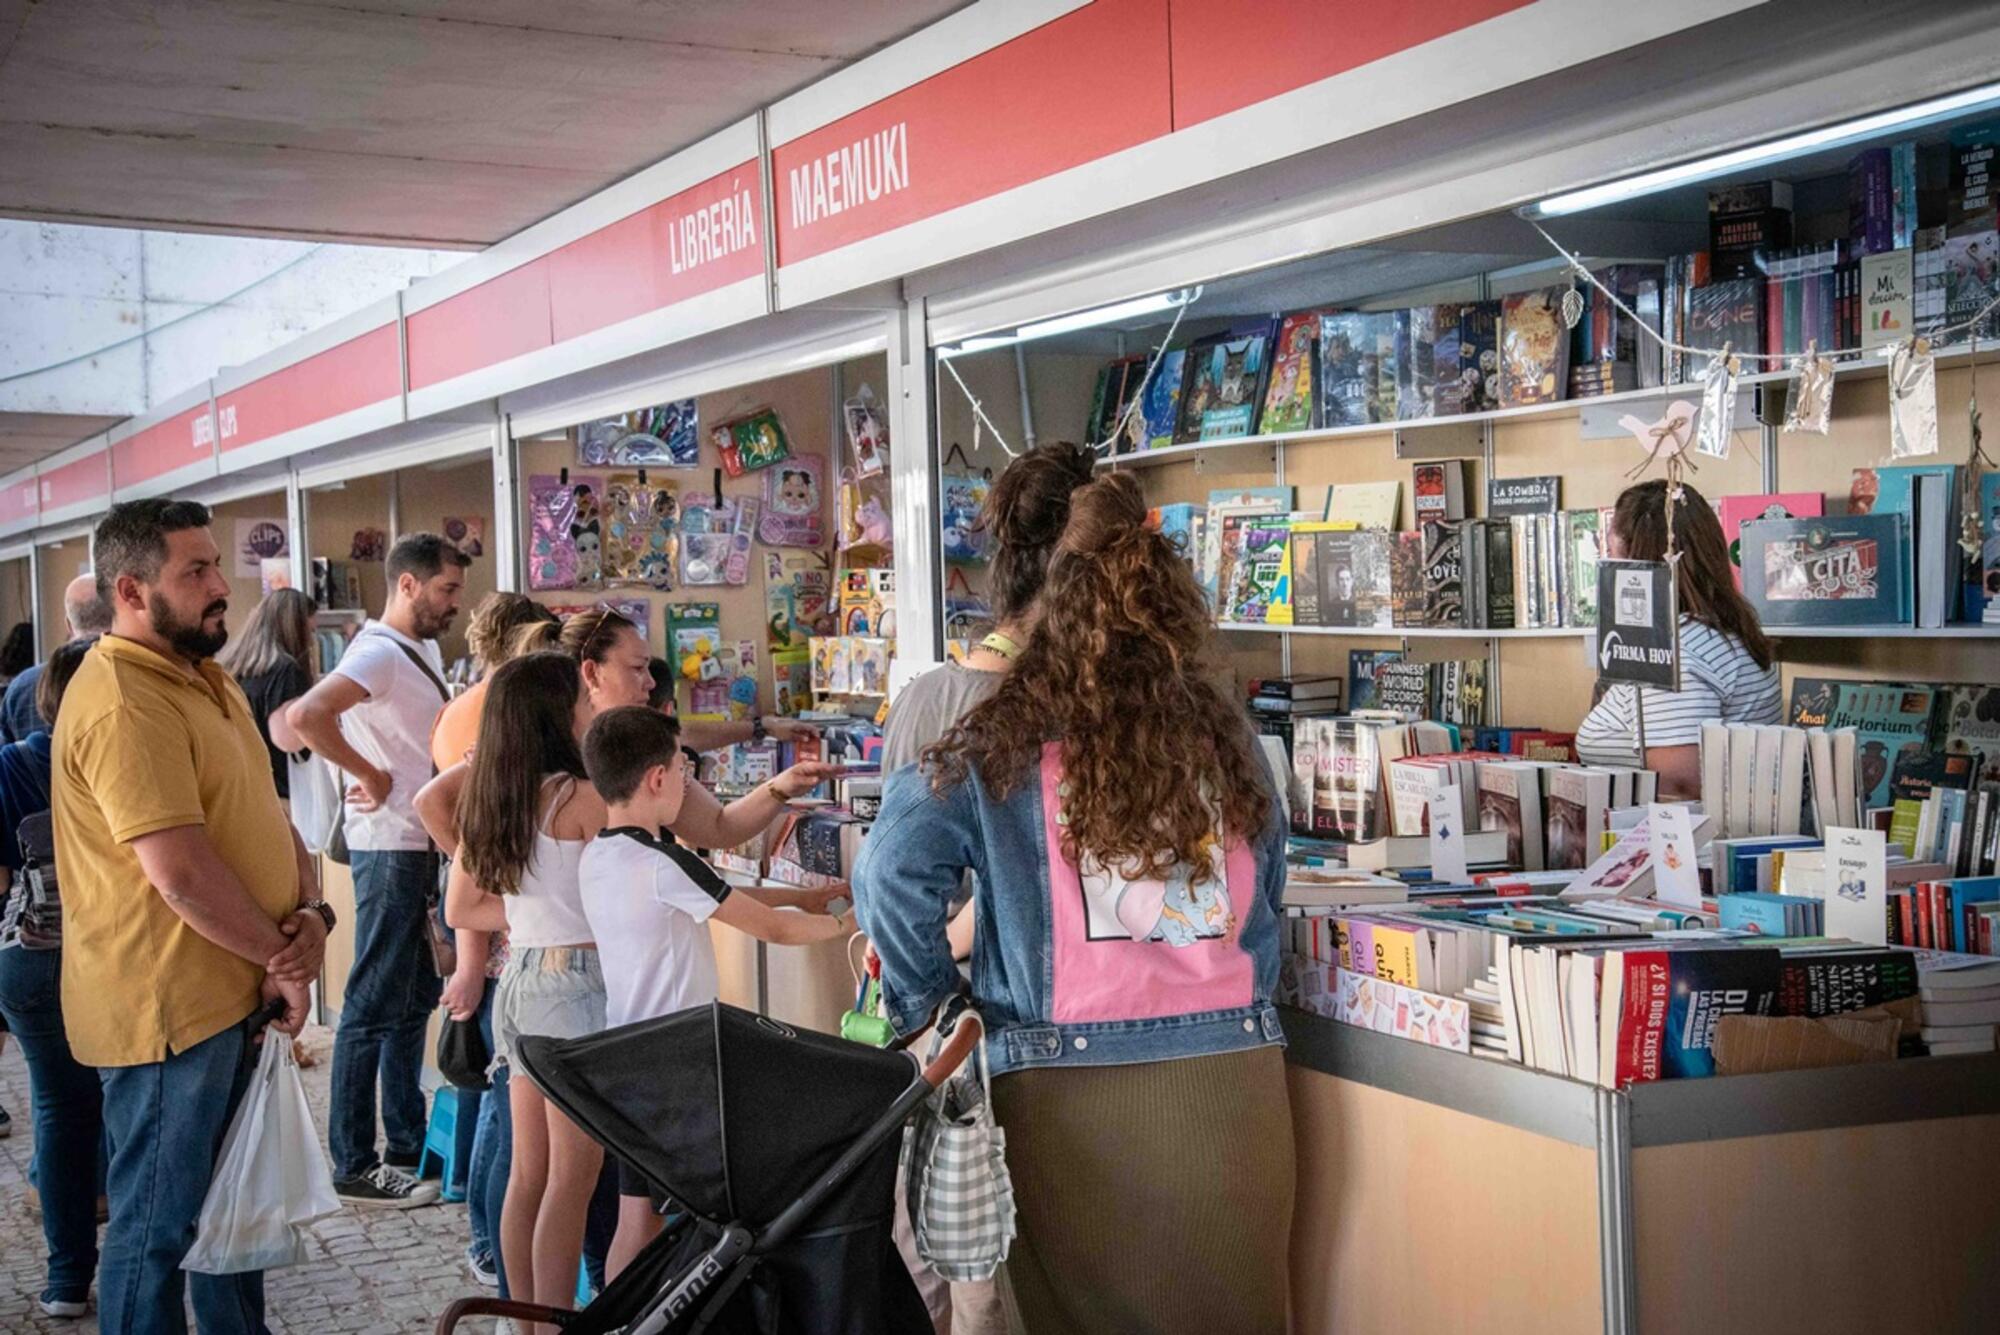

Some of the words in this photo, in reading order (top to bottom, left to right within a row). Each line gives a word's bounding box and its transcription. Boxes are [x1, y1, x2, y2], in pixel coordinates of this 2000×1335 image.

[790, 122, 909, 229] MAEMUKI
[669, 178, 756, 275] LIBRERÍA
[1877, 275, 1896, 292] Mi
[1493, 486, 1505, 498] LA
[1507, 484, 1548, 497] SOMBRA
[1812, 550, 1862, 580] CITA
[1613, 643, 1646, 663] FIRMA
[1649, 648, 1673, 665] HOY
[1383, 663, 1425, 676] GUINNESS
[1382, 675, 1424, 690] WORLD
[1382, 690, 1424, 704] RECORDS
[1796, 709, 1827, 725] Anat
[1833, 711, 1913, 734] Historium
[1650, 963, 1667, 981] ¿Y
[1651, 983, 1666, 997] SI
[1711, 990, 1725, 1005] LA
[1698, 991, 1710, 1009] LAS
[1647, 1000, 1665, 1028] DIOS
[1691, 1009, 1708, 1050] PRUEBAS
[1642, 1030, 1660, 1080] EXISTE?
